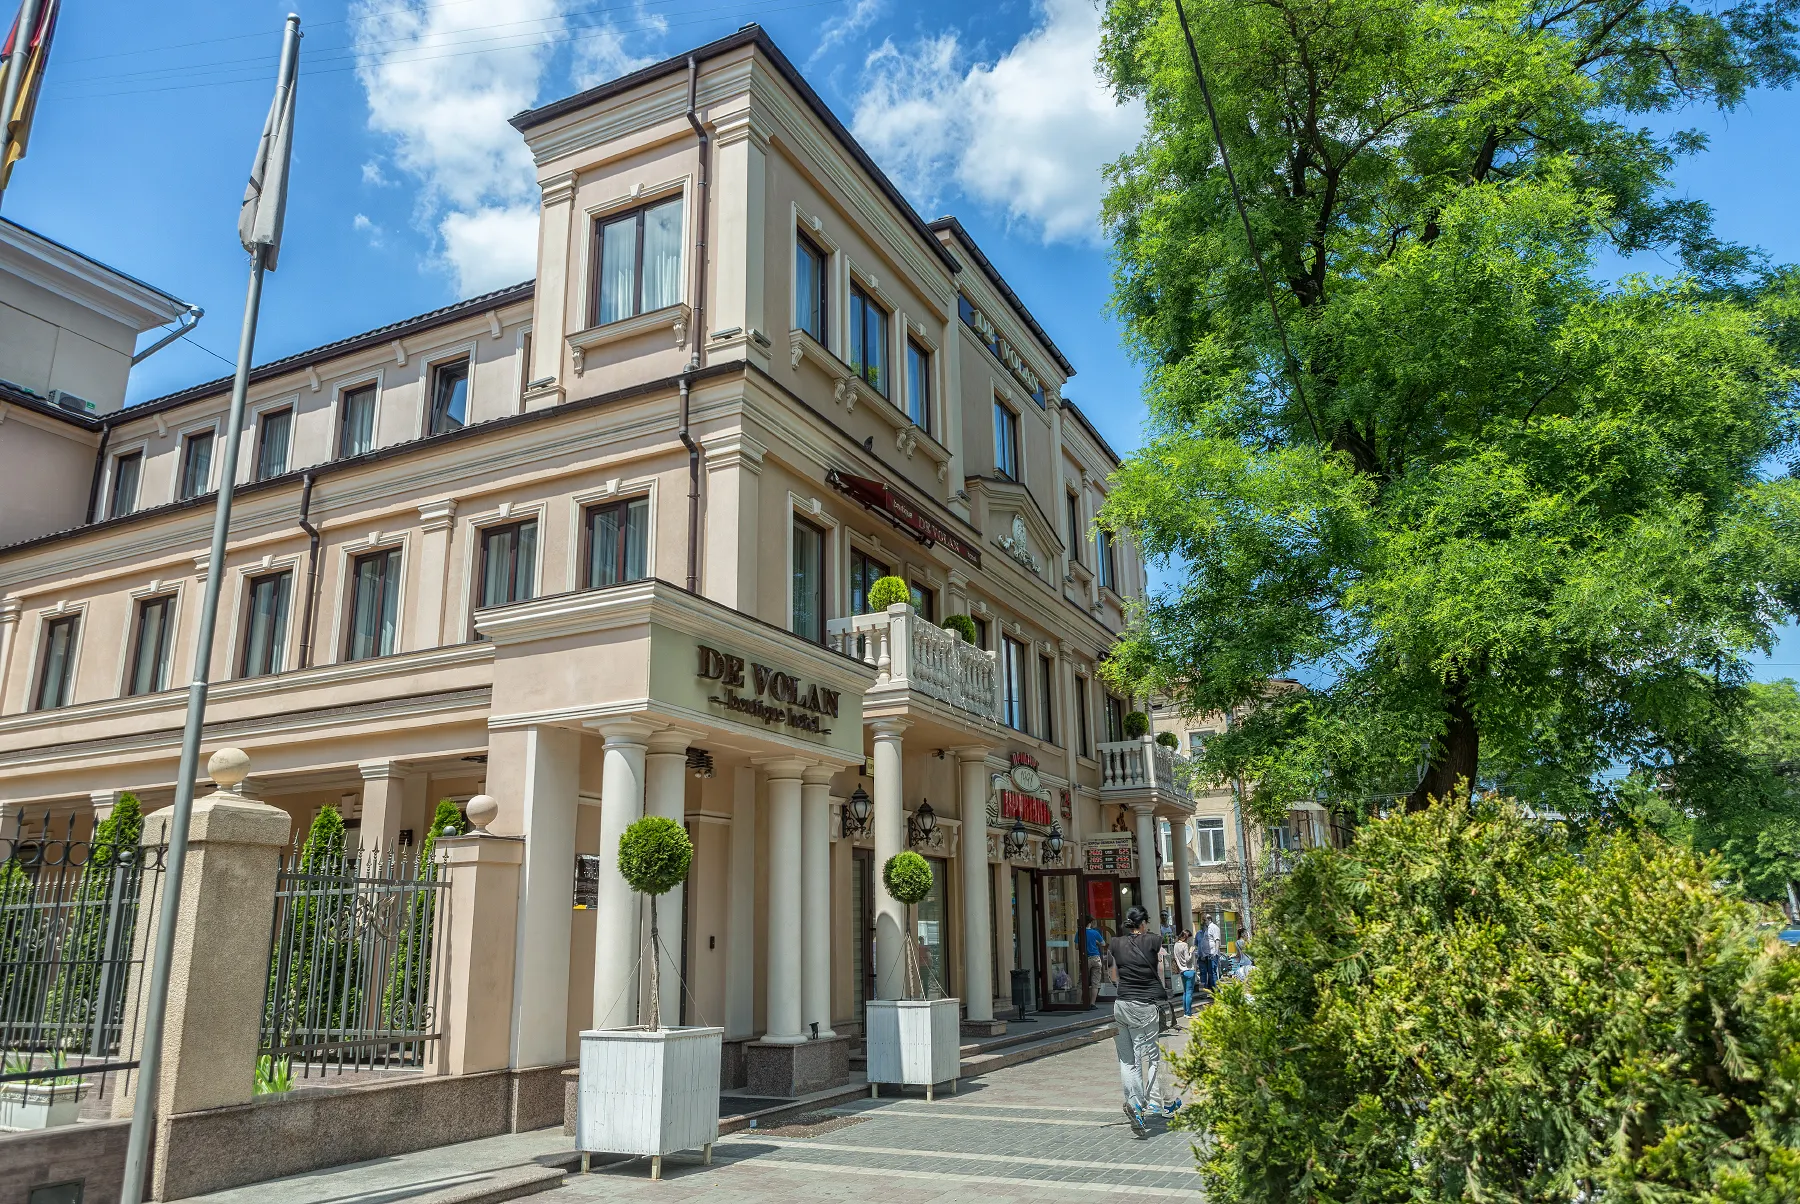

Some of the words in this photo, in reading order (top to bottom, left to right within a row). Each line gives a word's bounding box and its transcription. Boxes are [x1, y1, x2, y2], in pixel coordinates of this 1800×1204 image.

[973, 309, 995, 344] DE
[999, 339, 1039, 394] VOLAN
[697, 644, 745, 688] DE
[751, 662, 841, 719] VOLAN
[724, 688, 785, 725] boutique
[787, 707, 820, 734] hotel
